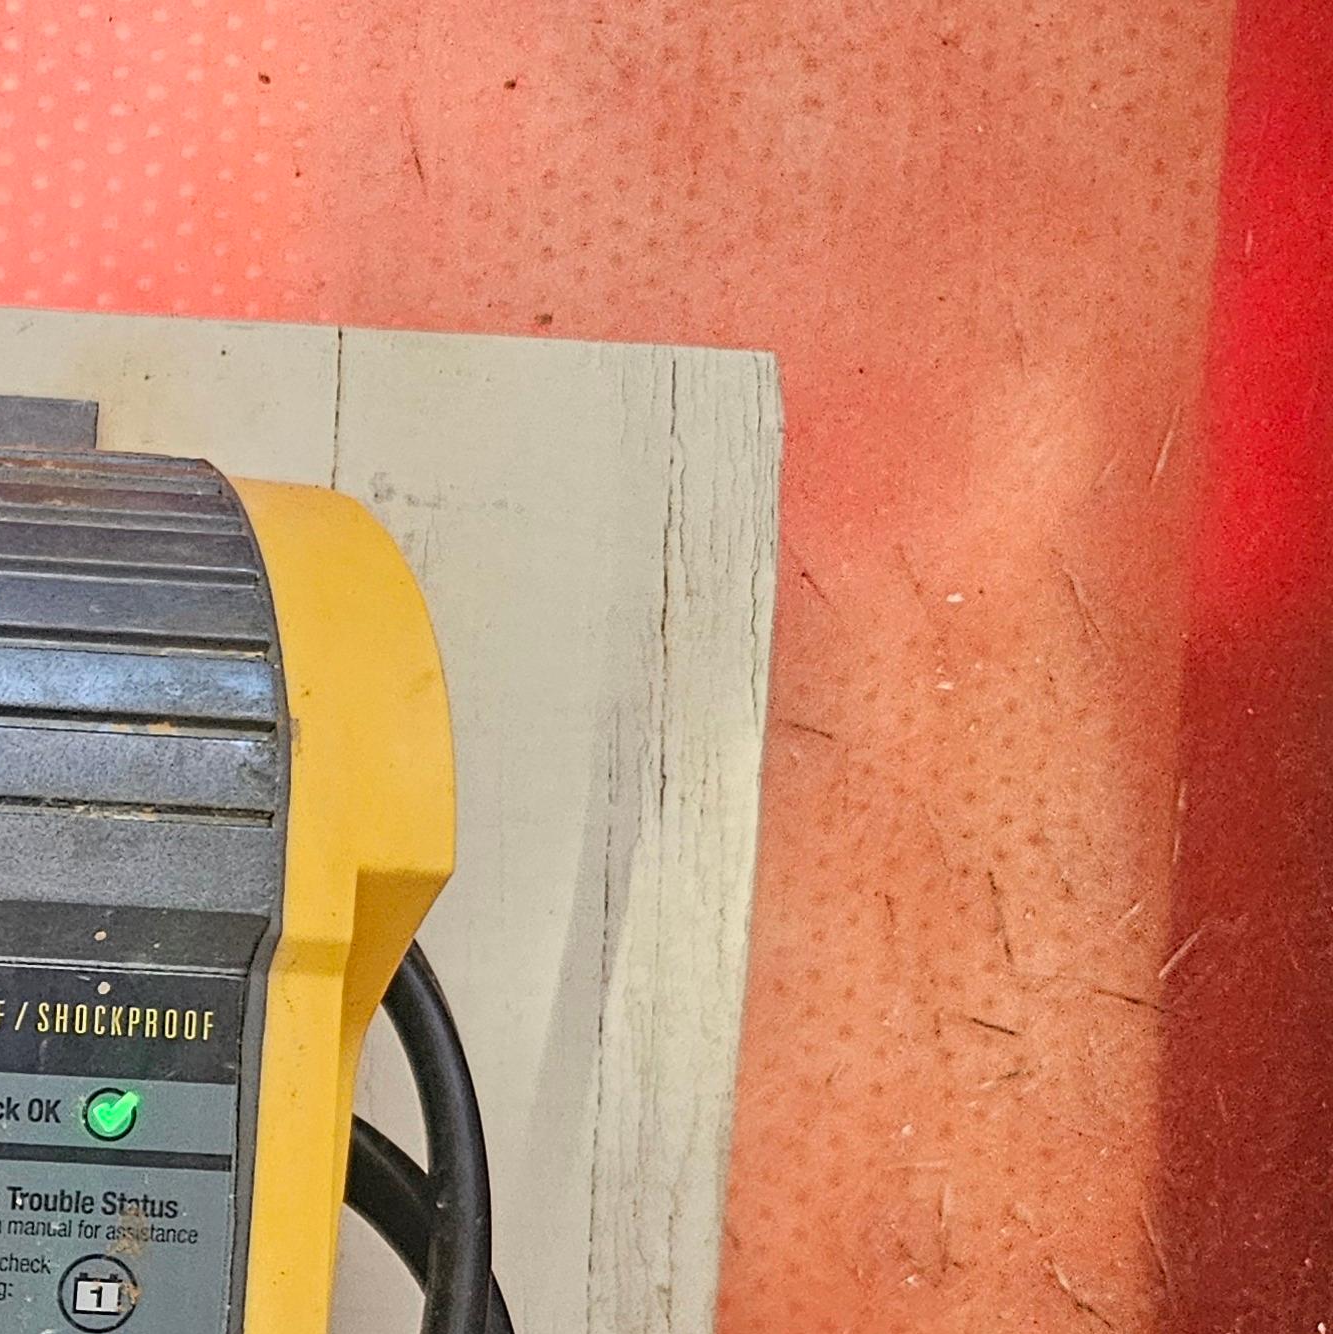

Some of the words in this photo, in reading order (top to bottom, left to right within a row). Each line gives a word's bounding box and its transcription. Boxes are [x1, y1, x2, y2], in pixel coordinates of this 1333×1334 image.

[37, 1004, 215, 1042] SHOCKPROOF
[27, 1099, 62, 1123] OK
[6, 1186, 95, 1215] Trouble
[101, 1191, 178, 1218] Status
[8, 1217, 72, 1238] manual
[77, 1216, 101, 1240] for
[0, 1253, 51, 1275] check
[89, 1286, 103, 1308] 1
